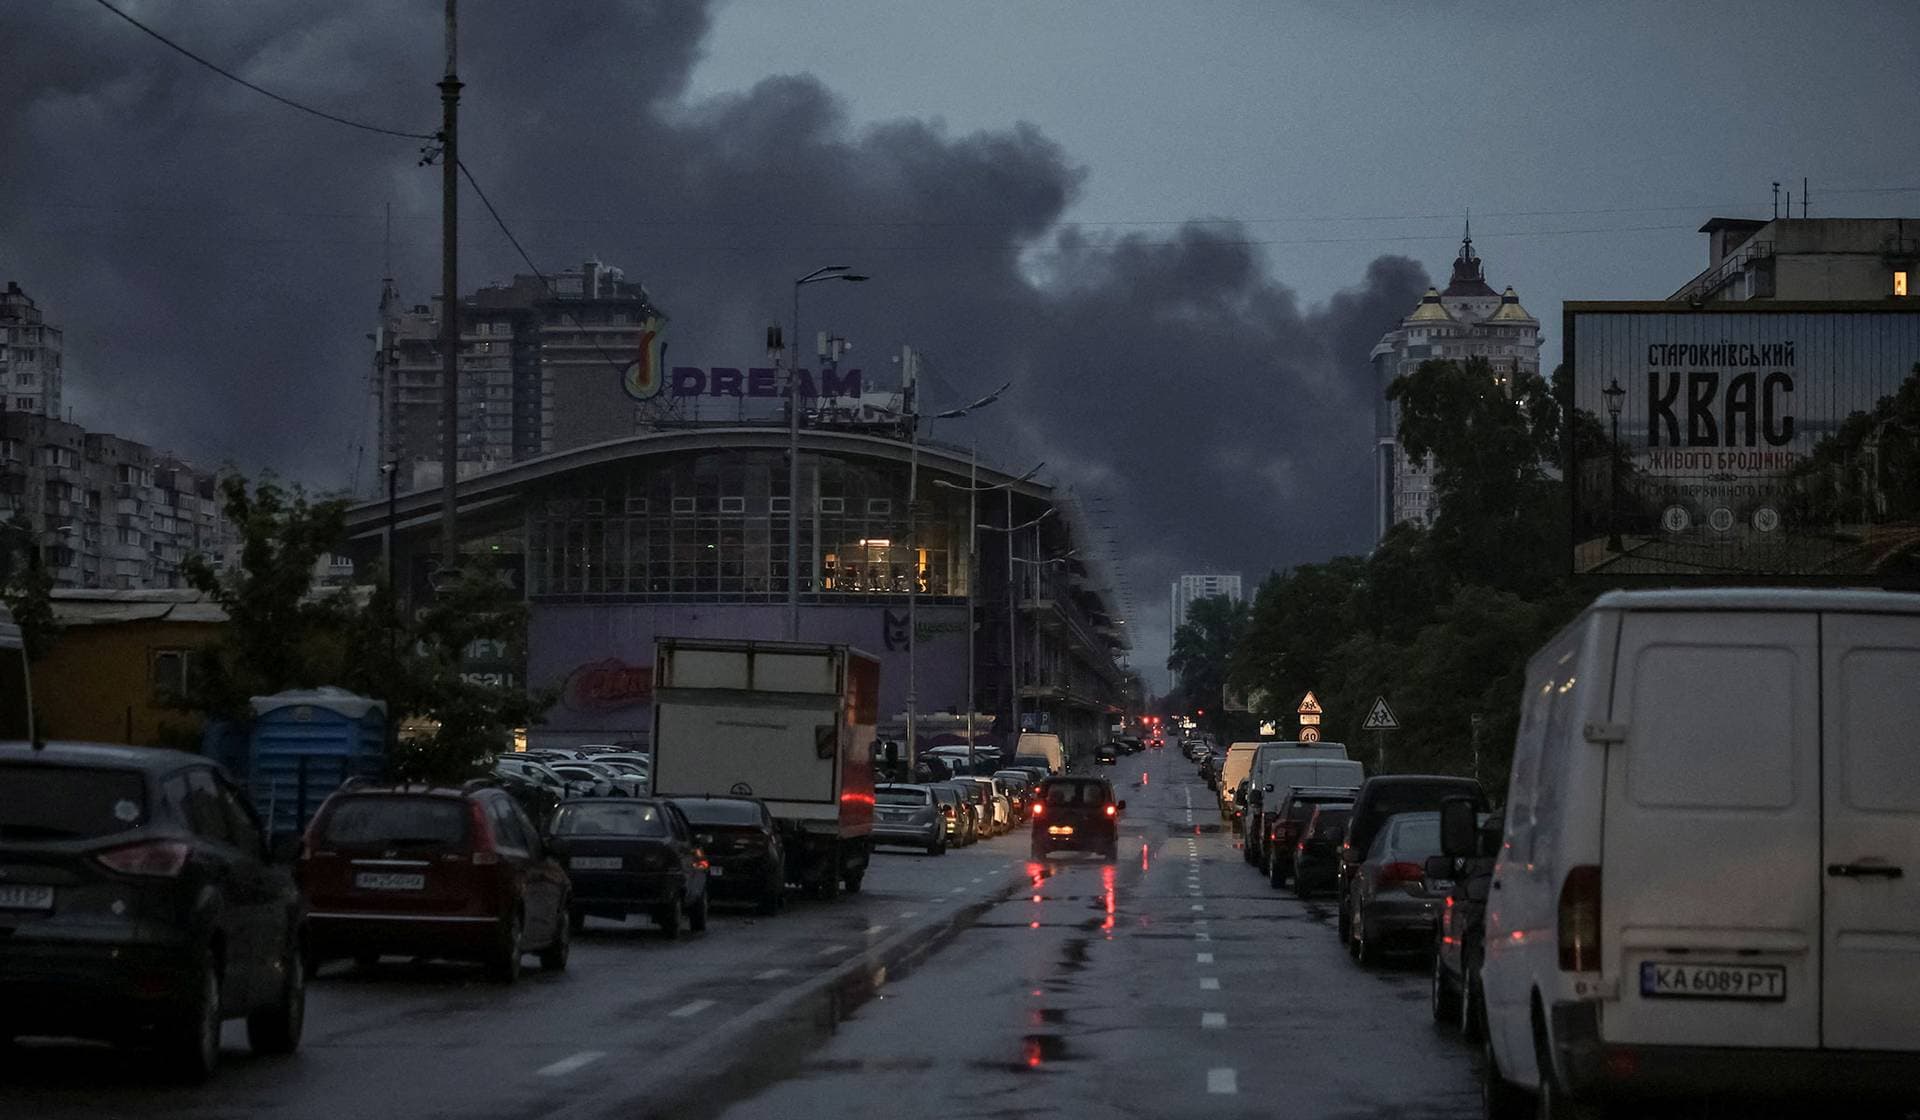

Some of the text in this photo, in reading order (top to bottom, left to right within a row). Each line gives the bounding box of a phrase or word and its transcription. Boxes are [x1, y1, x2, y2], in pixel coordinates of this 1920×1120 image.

[1648, 340, 1795, 367] СТАРОКИЇВСЬКИЙ
[672, 367, 862, 398] DREAM
[1649, 372, 1794, 447] КВАС
[1648, 452, 1794, 471] ЖИВОГО БРОДІННЯ
[1304, 733, 1316, 742] 40
